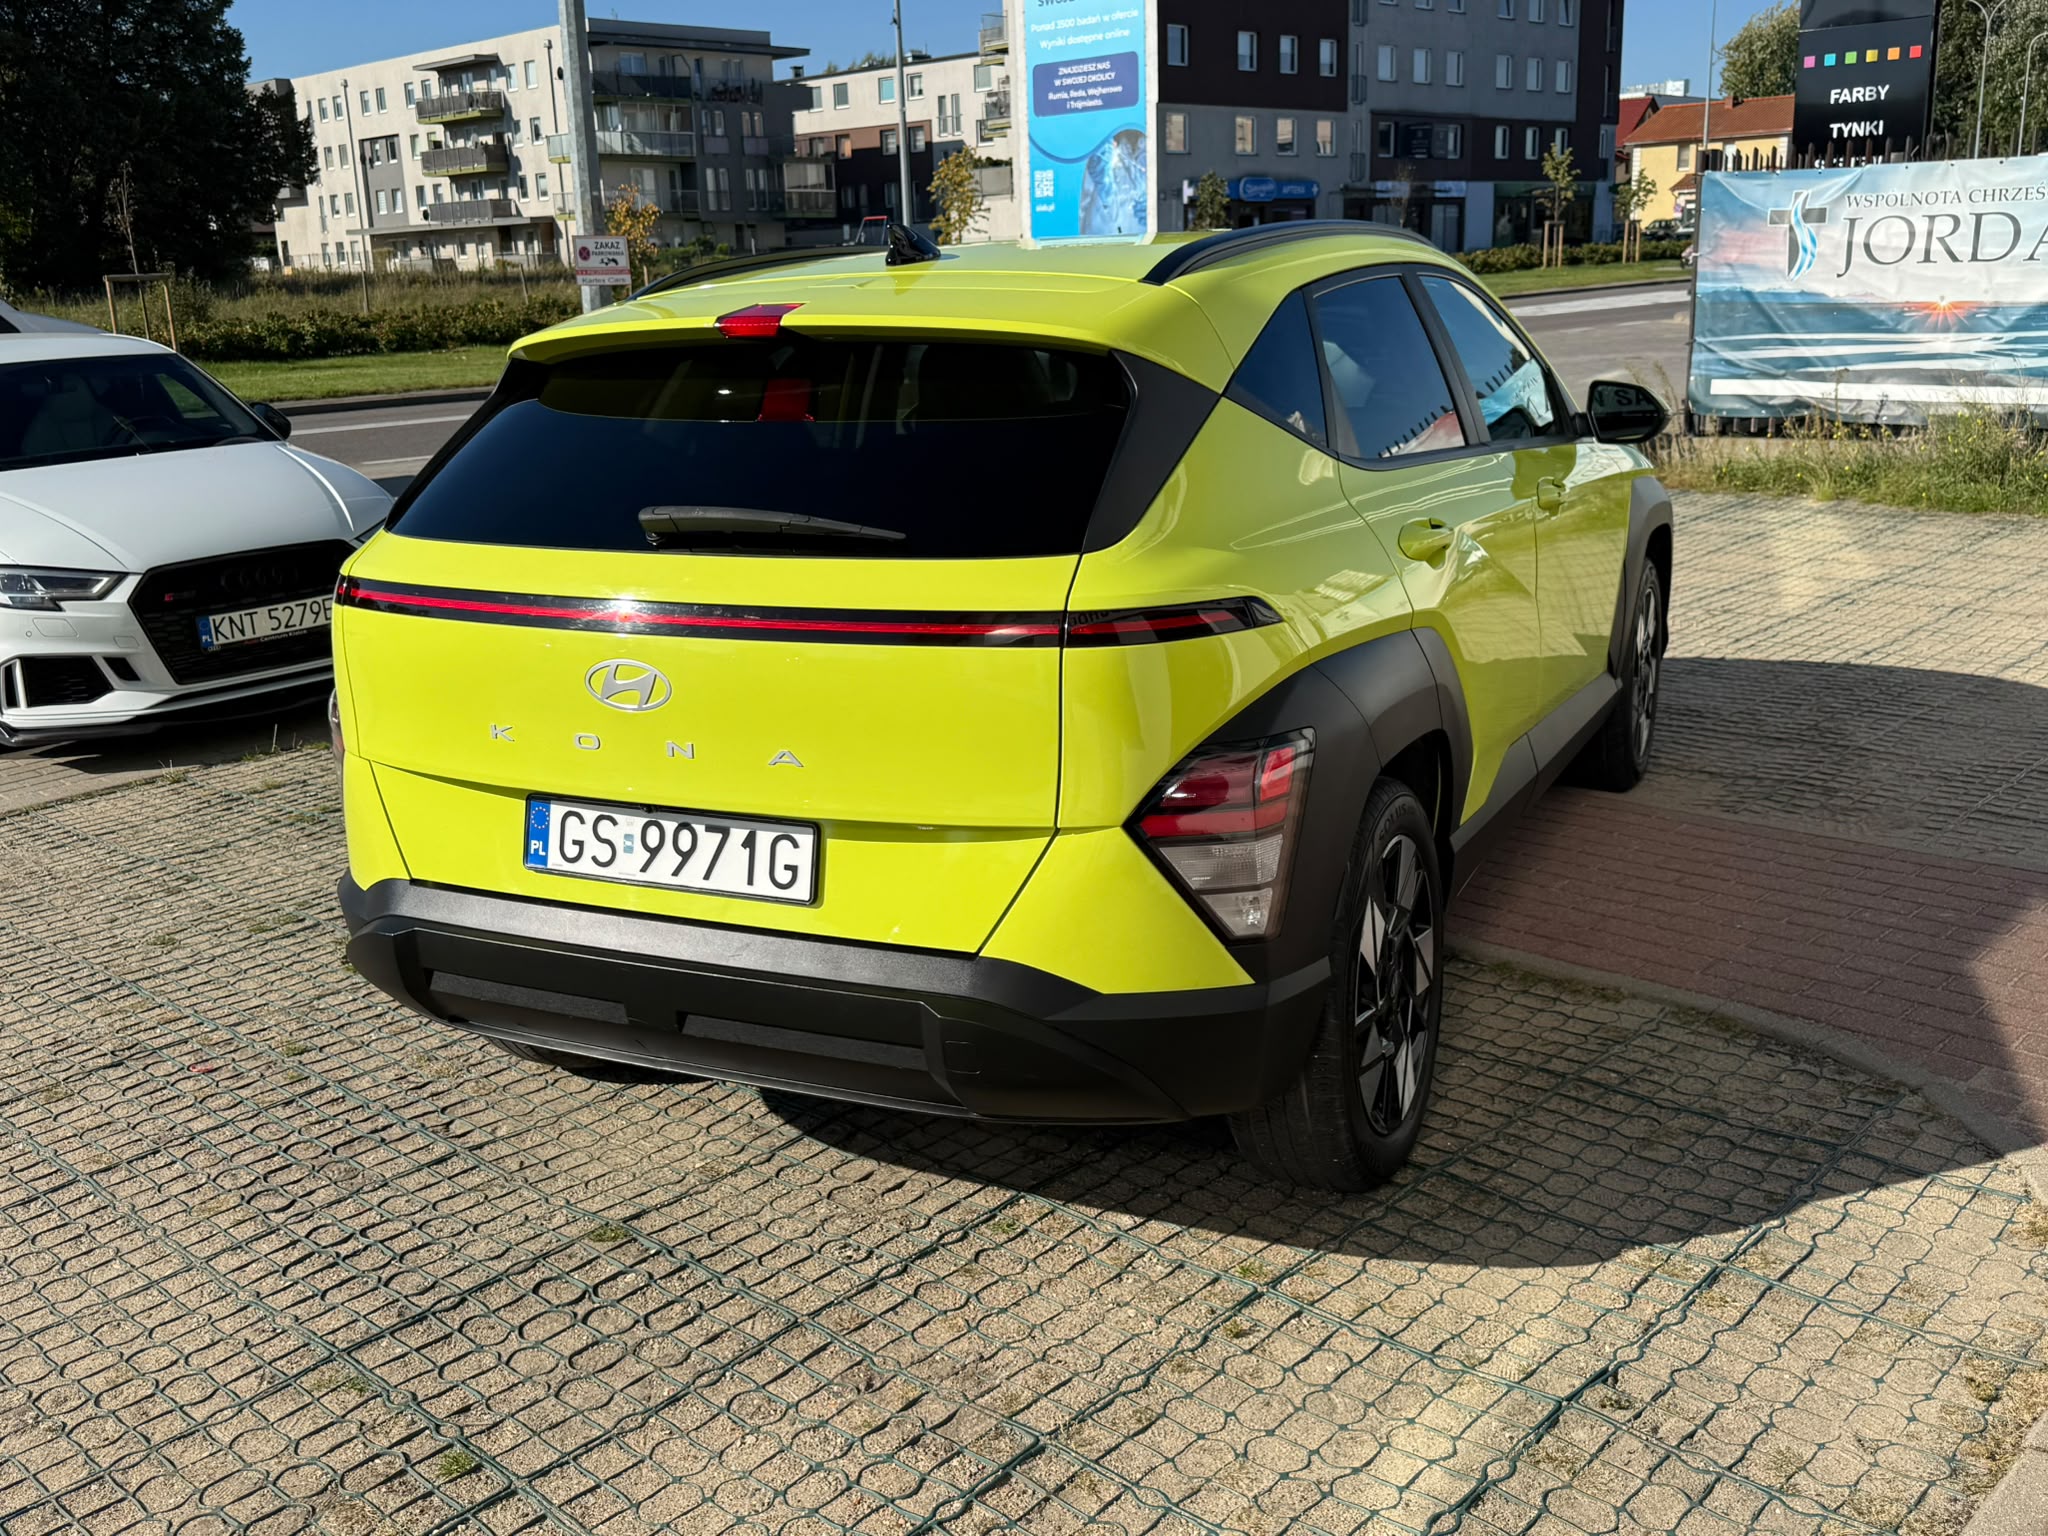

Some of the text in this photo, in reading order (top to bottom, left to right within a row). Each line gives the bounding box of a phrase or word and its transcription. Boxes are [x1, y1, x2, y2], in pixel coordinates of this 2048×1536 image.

[1031, 21, 1055, 32] Ponad
[1111, 9, 1139, 21] ofercie
[1040, 29, 1130, 50] Wyniki dostępne online
[1097, 61, 1111, 70] NAS
[1062, 75, 1087, 86] SWOJEJ
[1087, 72, 1116, 82] OKOLICY
[1829, 84, 1890, 105] FARBY
[1829, 119, 1884, 139] TYNKI
[1846, 181, 2048, 209] WSPÓLNOTA CHRZEŚ
[594, 241, 621, 250] ZAKAZ
[212, 612, 258, 642] KNT
[202, 635, 213, 643] PL
[490, 723, 804, 768] KONA
[530, 839, 547, 857] PL
[559, 810, 800, 890] GS 9971G
